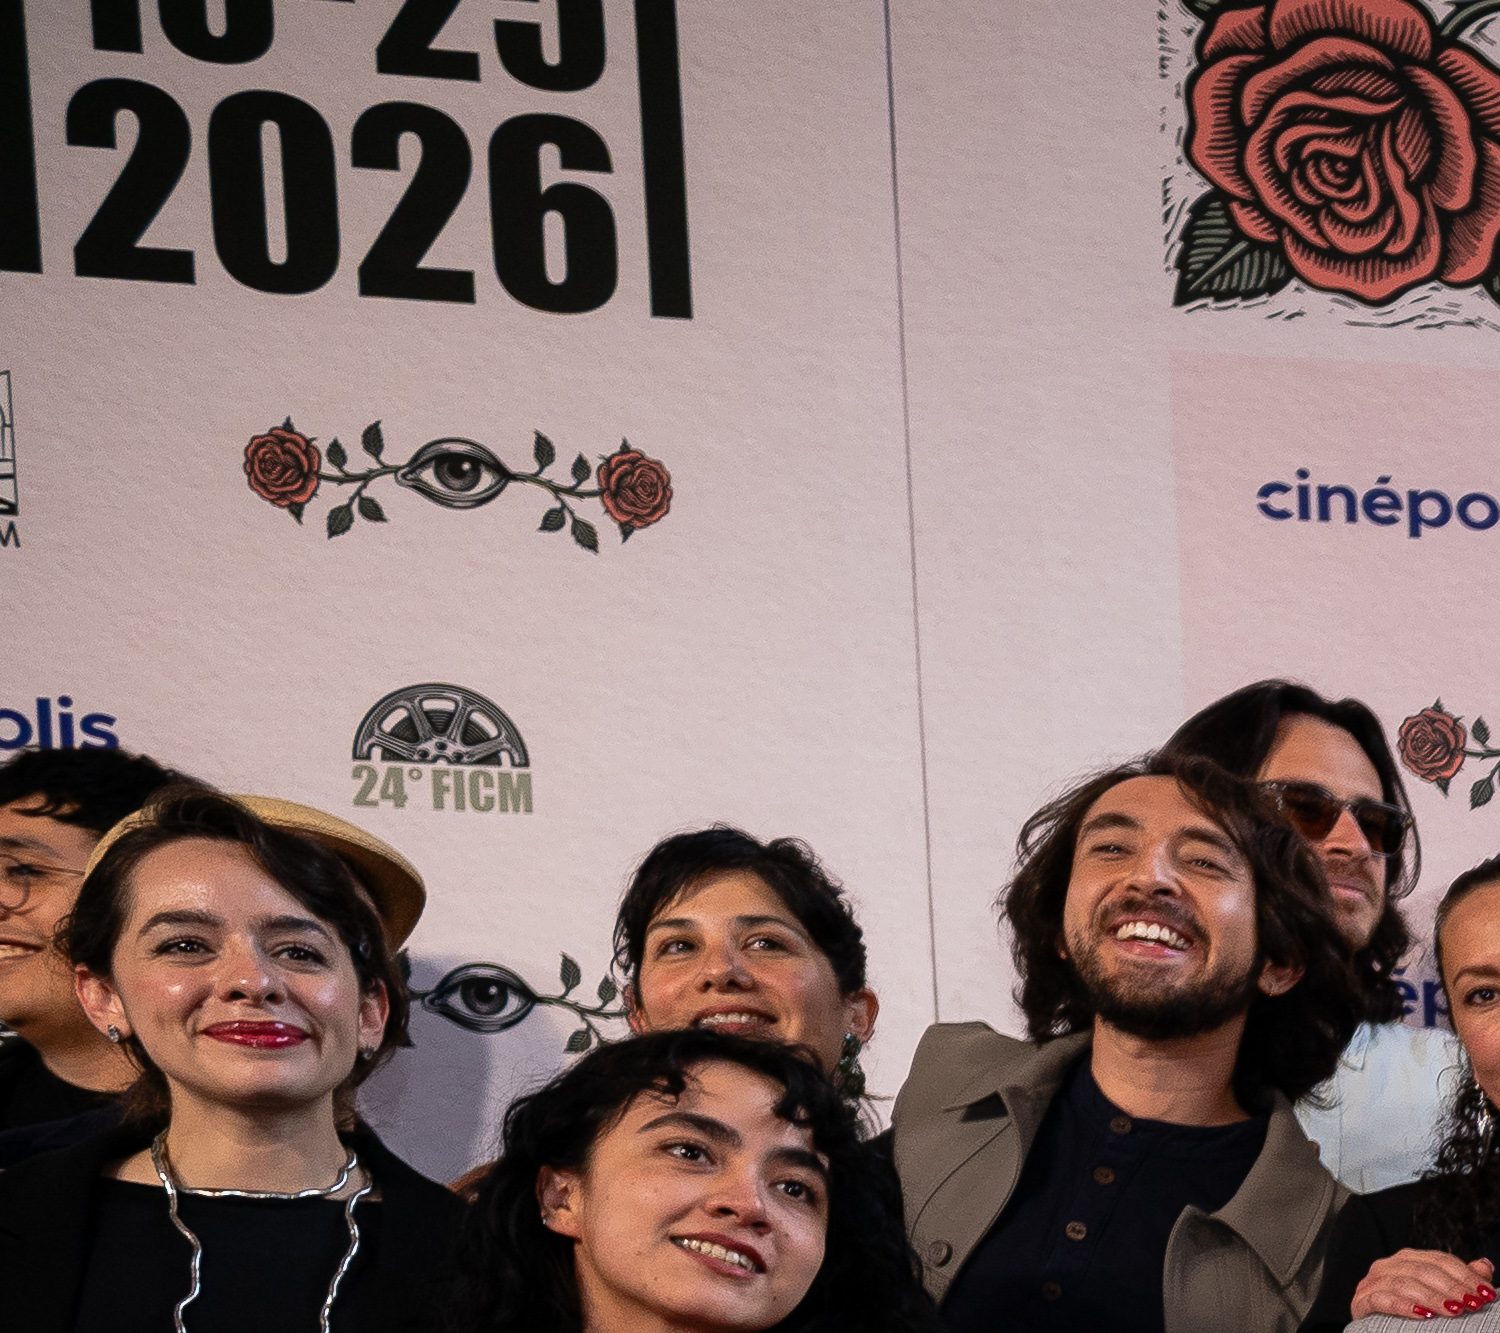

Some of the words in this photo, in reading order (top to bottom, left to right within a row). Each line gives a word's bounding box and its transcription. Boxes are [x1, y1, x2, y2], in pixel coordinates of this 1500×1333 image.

[65, 77, 619, 314] 2026
[351, 765, 423, 808] 24°
[432, 769, 533, 814] FICM
